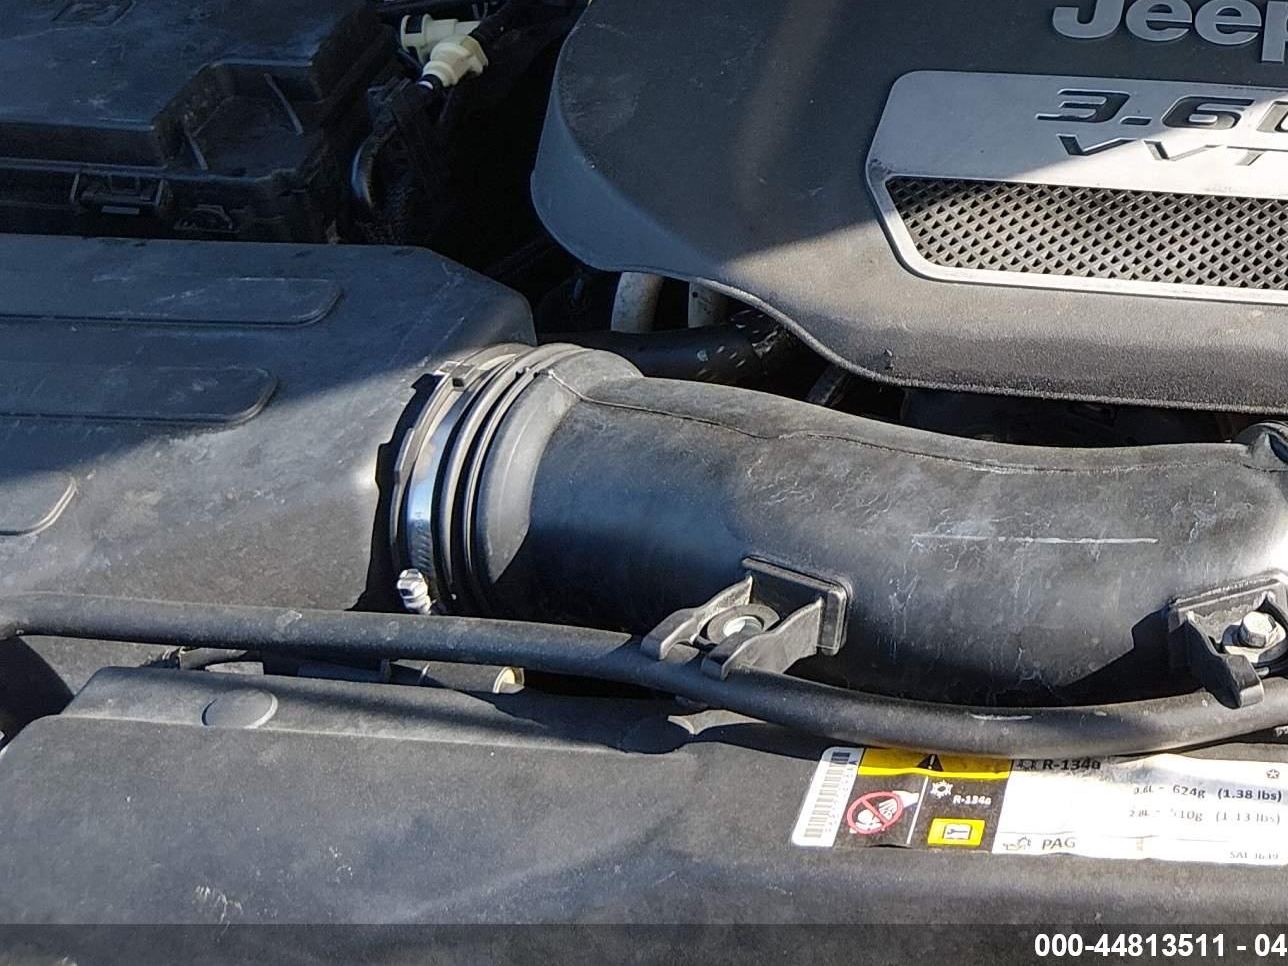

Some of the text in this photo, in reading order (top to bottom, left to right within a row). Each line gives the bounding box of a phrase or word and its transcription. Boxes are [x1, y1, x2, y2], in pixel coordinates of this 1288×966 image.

[1042, 758, 1101, 771] R-134a
[1172, 784, 1206, 799] 624g
[1217, 787, 1253, 801] (1.38
[1257, 789, 1282, 803] lbs)
[1129, 809, 1150, 818] 28L
[1216, 810, 1250, 823] (113
[1041, 836, 1077, 849] PAG
